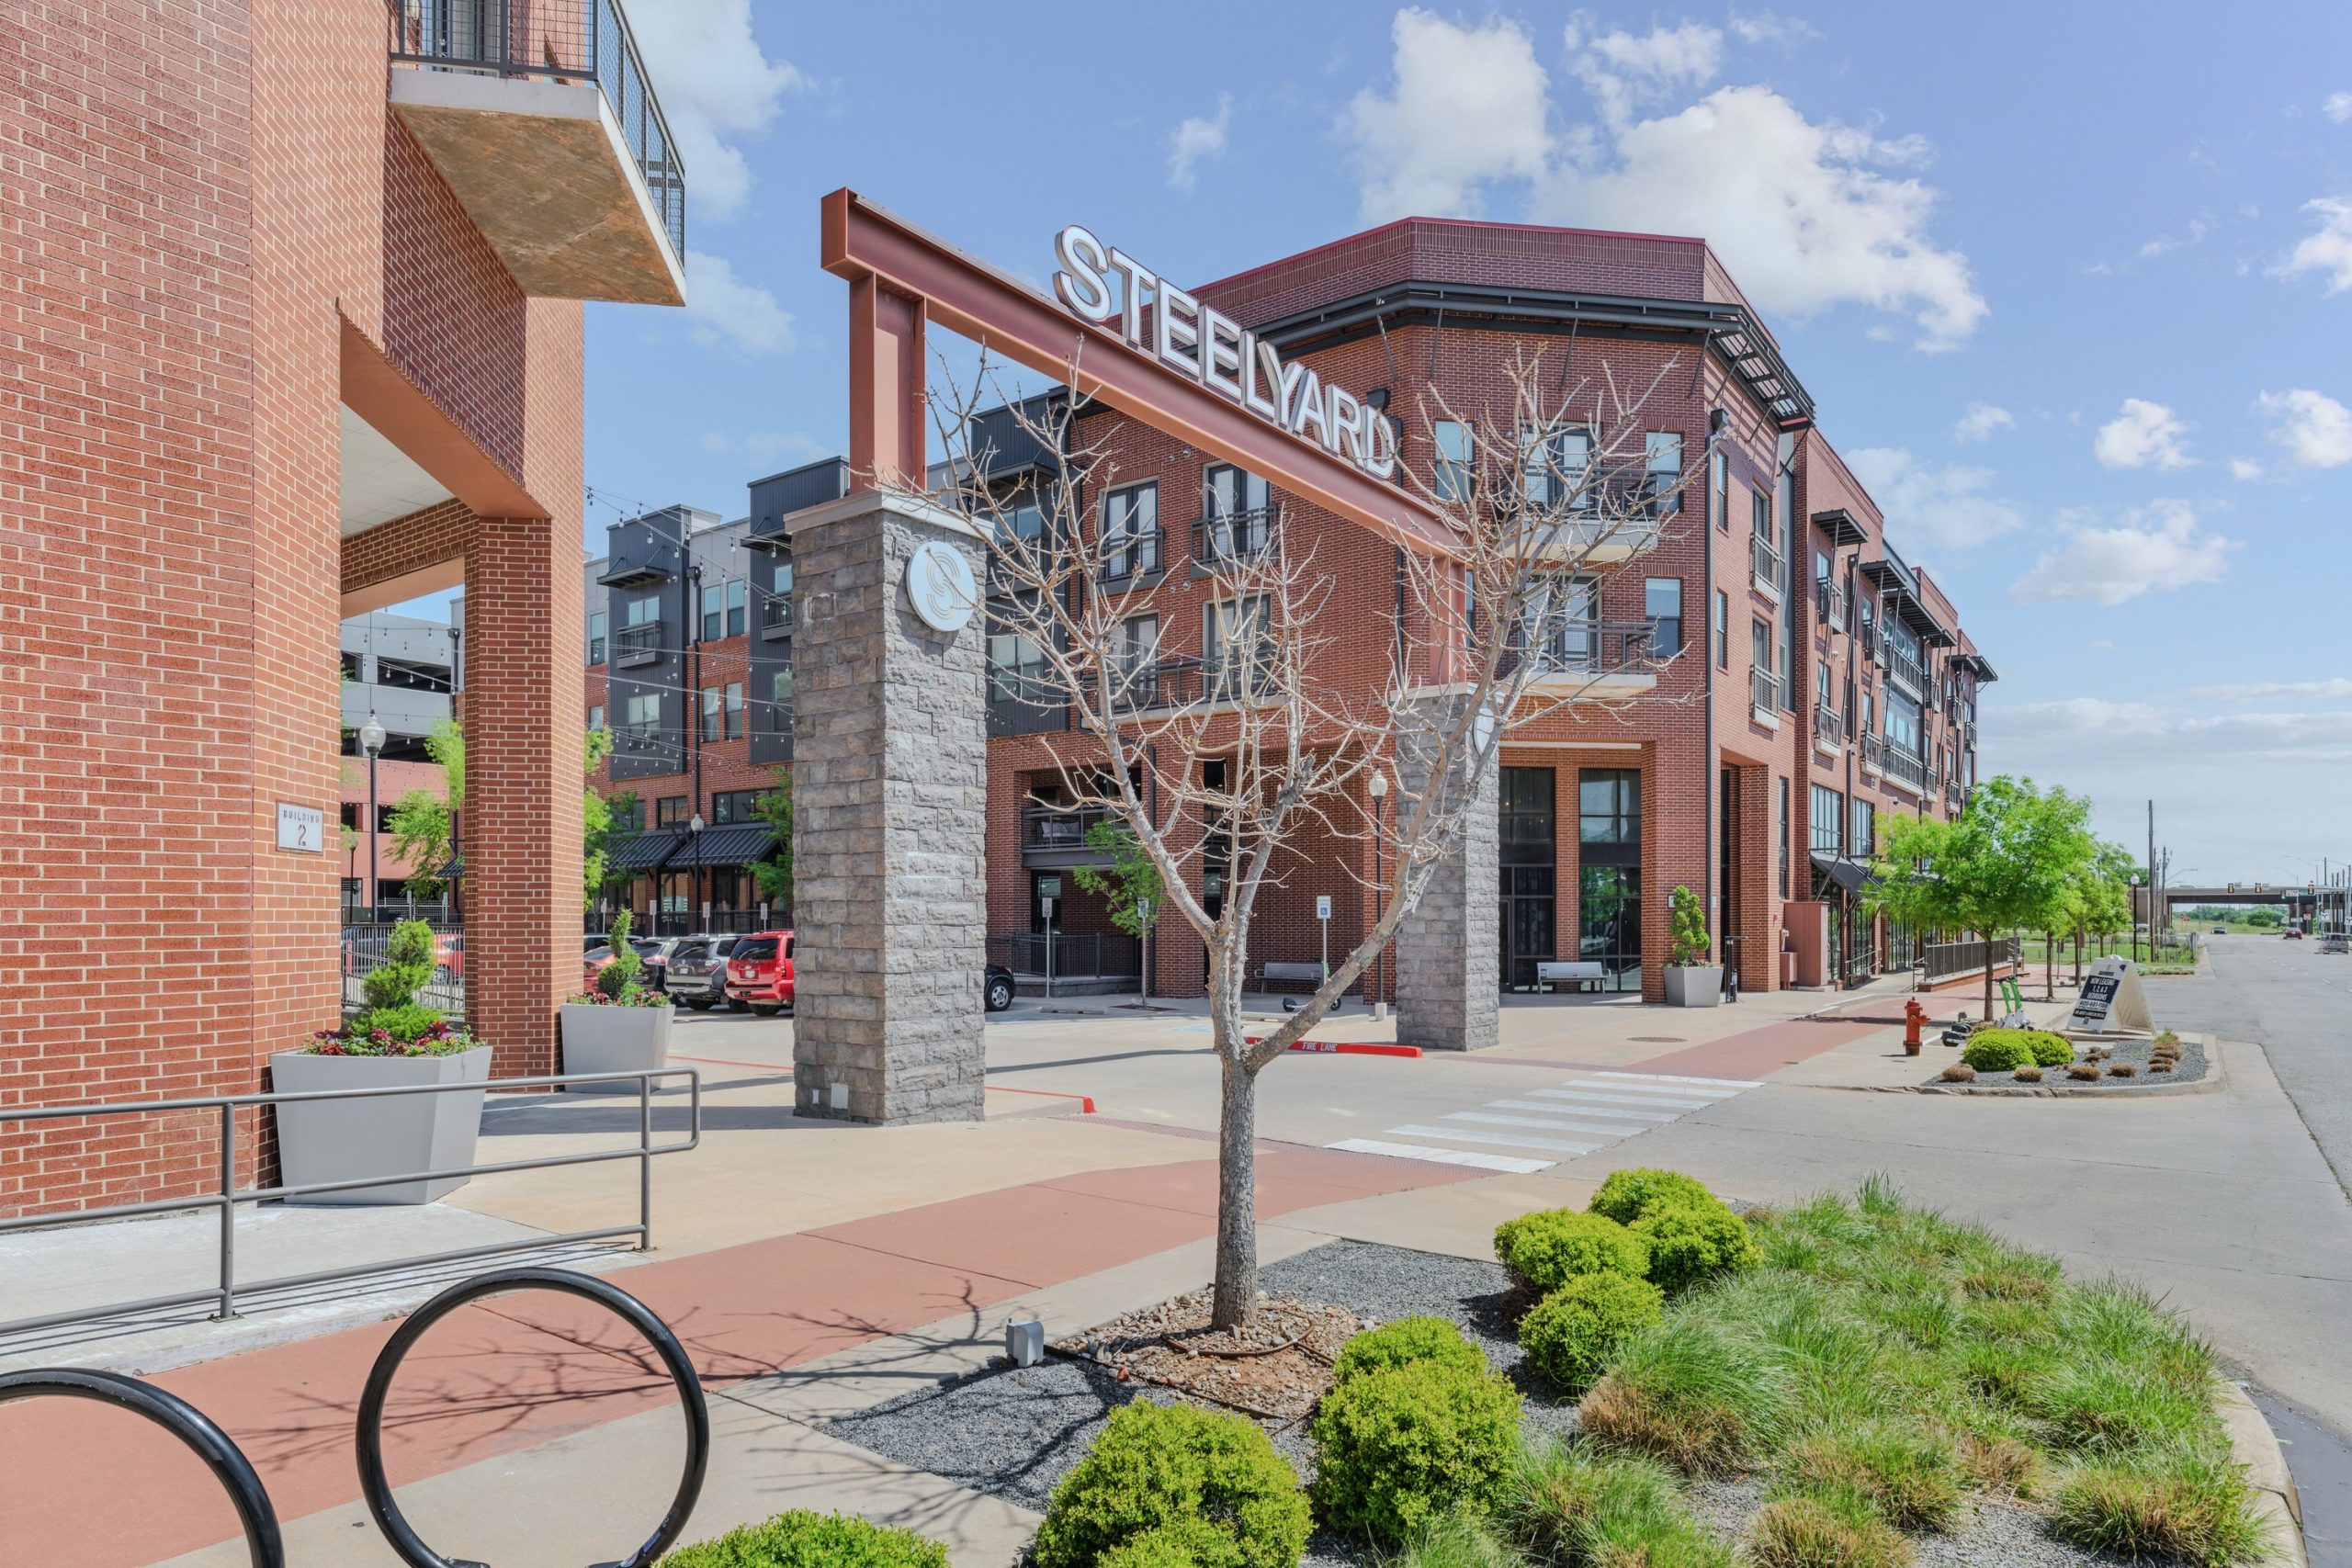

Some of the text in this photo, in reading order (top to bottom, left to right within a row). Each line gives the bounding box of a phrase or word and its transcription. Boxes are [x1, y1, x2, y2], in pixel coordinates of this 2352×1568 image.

[1052, 224, 1396, 479] STEELYARD
[283, 809, 320, 824] BUILDING
[298, 824, 307, 846] 2
[2087, 992, 2108, 1000] BEDROOMS
[1302, 1042, 1338, 1052] FIRE LANE
